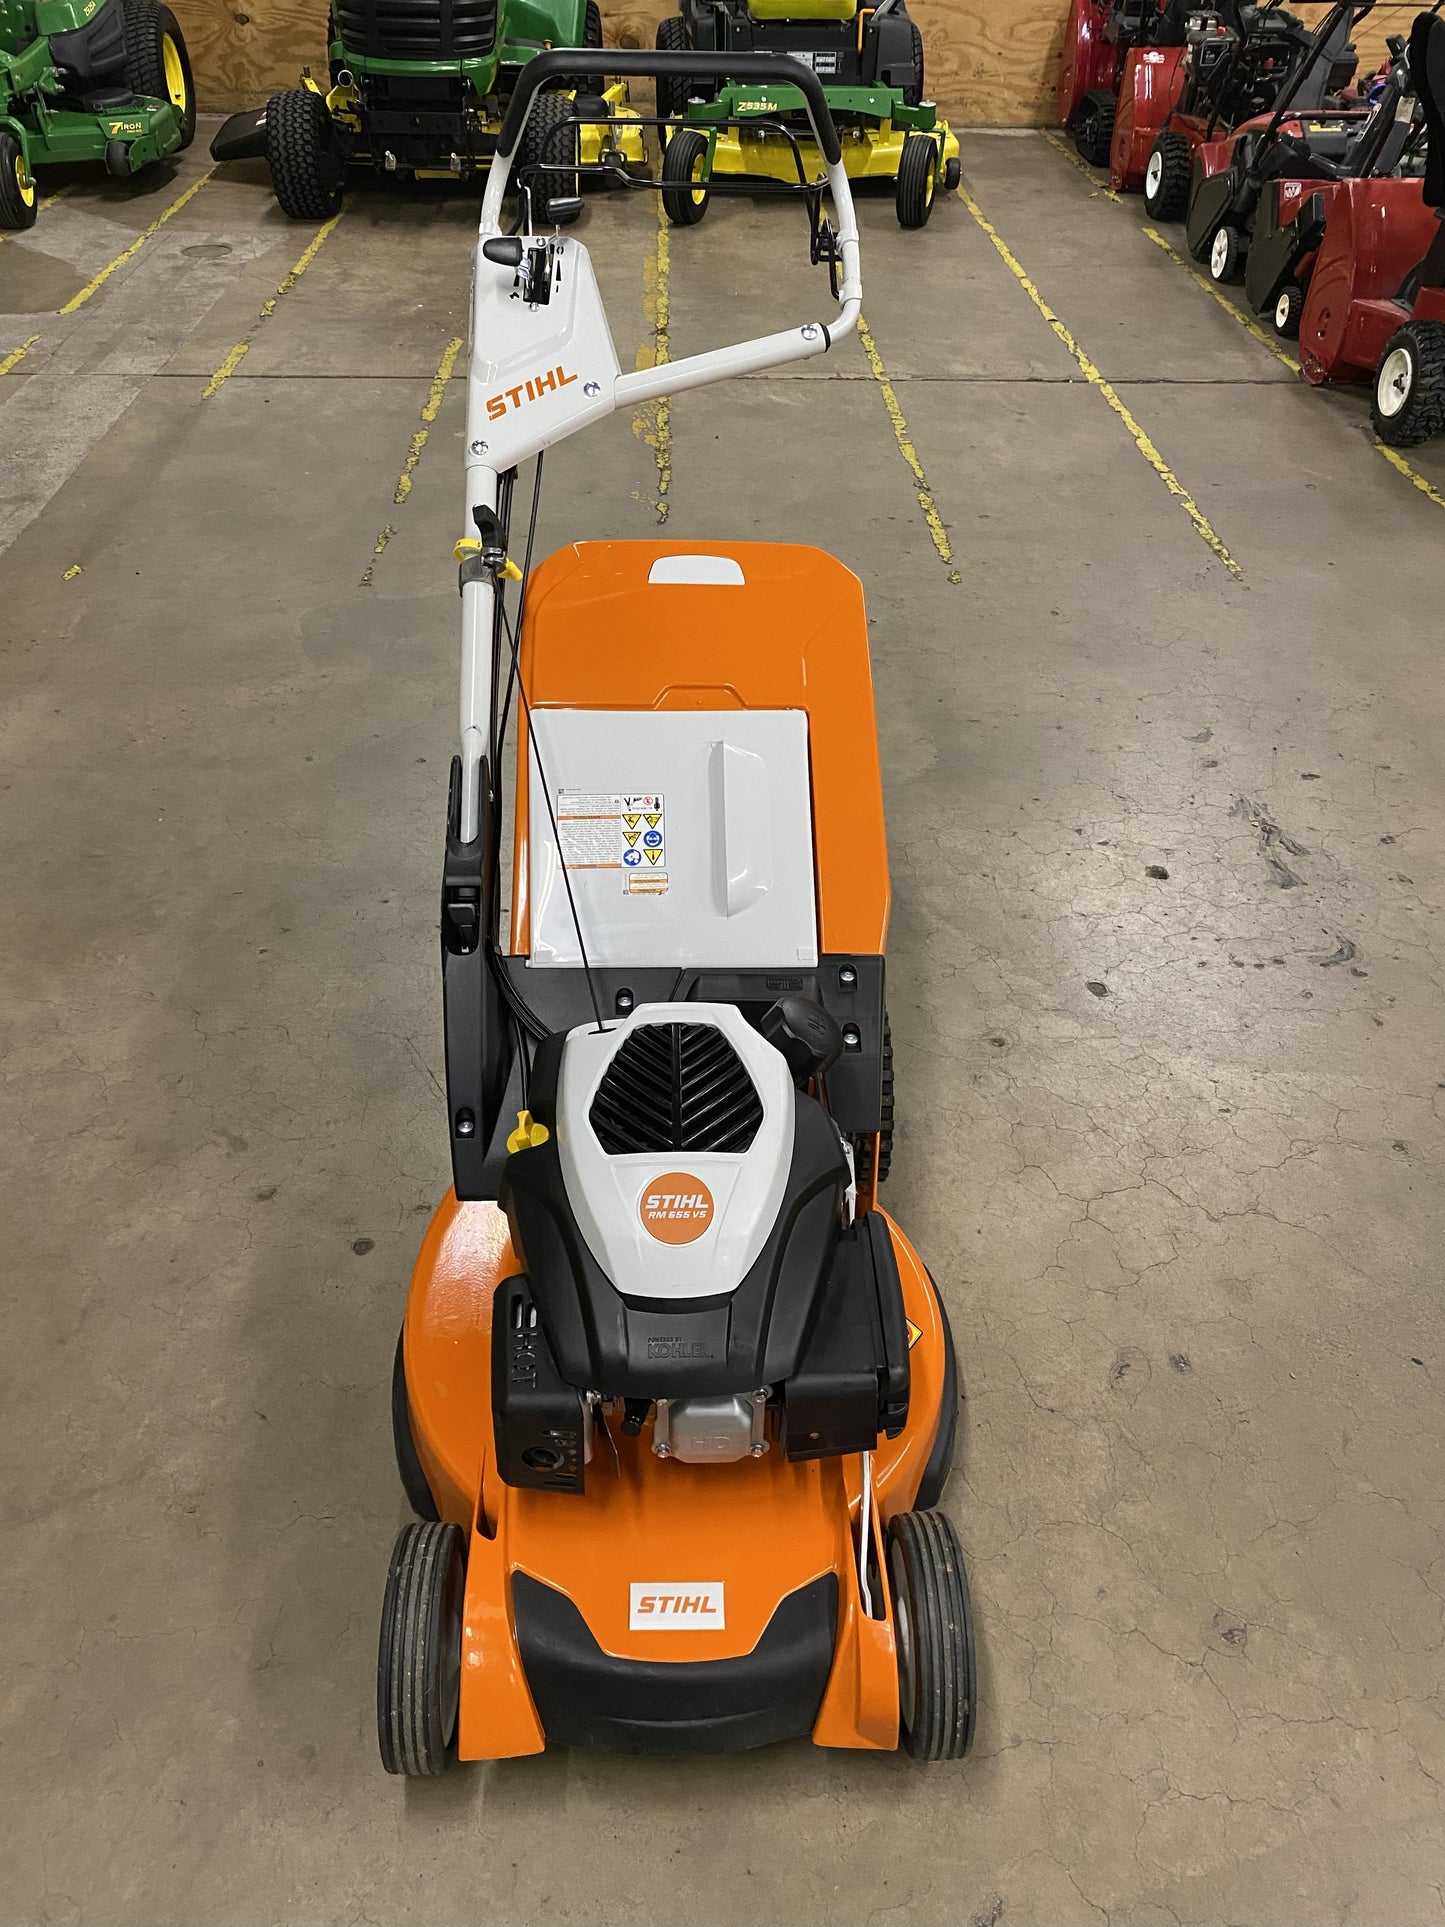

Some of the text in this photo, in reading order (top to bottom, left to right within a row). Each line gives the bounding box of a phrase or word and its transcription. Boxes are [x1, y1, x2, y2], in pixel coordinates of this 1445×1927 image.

[736, 101, 778, 112] Z535M
[486, 365, 578, 421] STIHL
[645, 1194, 709, 1209] STIHL
[647, 1210, 707, 1219] RM 655 VS
[637, 1595, 717, 1614] STIHL
